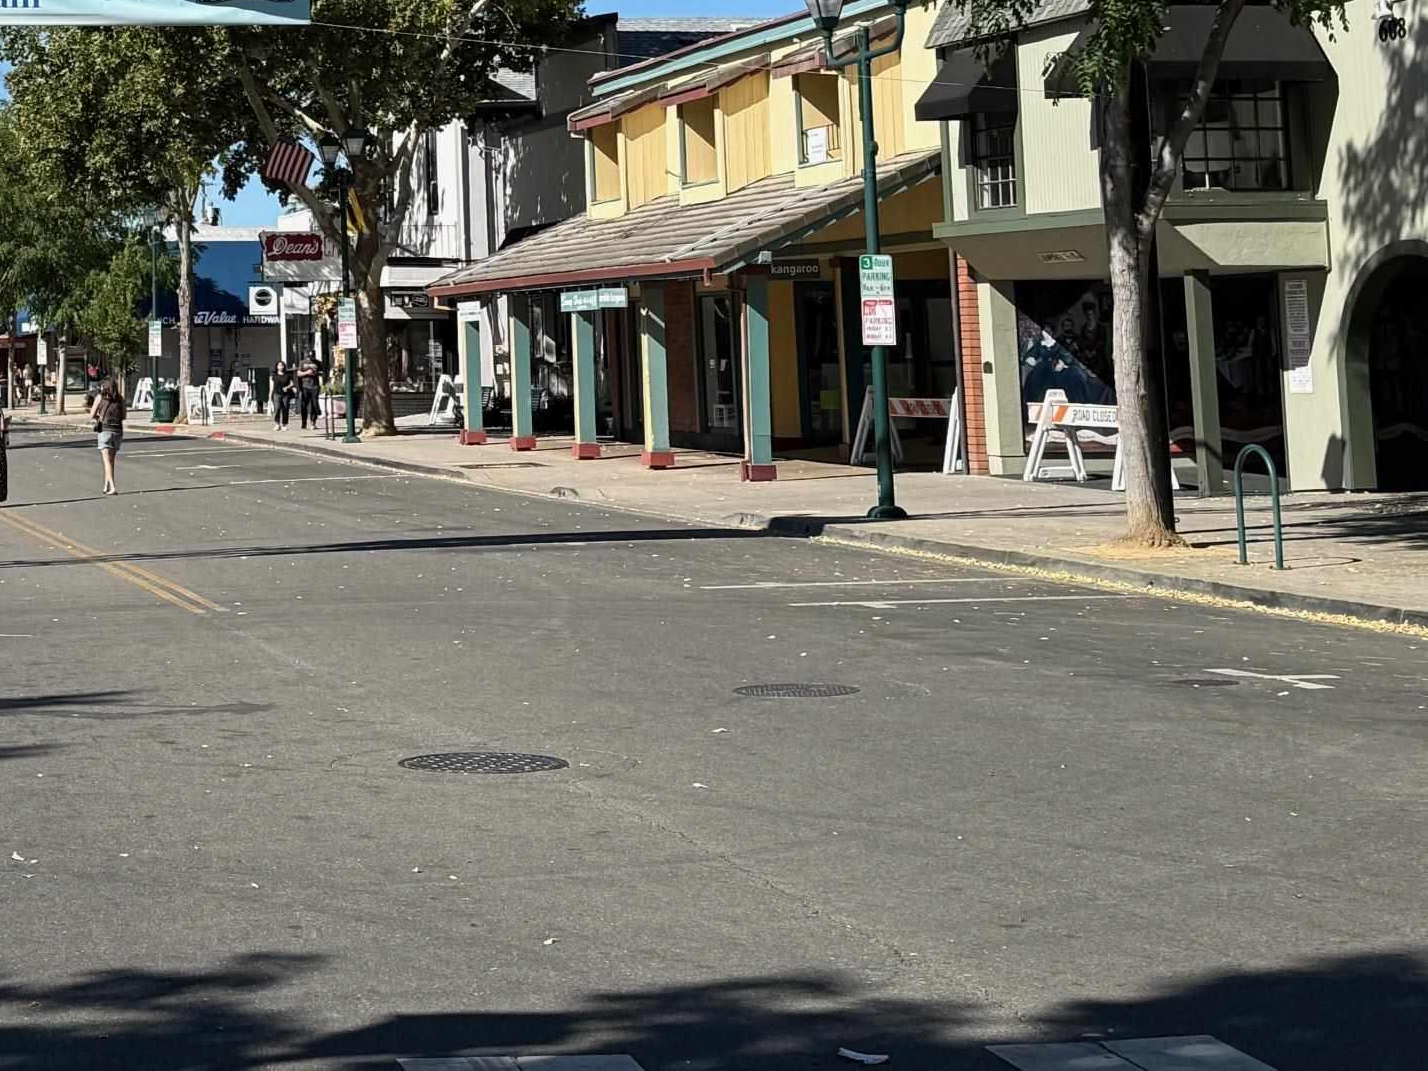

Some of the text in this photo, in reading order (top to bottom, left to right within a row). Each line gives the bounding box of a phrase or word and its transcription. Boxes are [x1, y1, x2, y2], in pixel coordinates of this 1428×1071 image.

[862, 257, 871, 269] 3
[770, 264, 819, 277] kangaroo
[862, 272, 892, 282] PARKING
